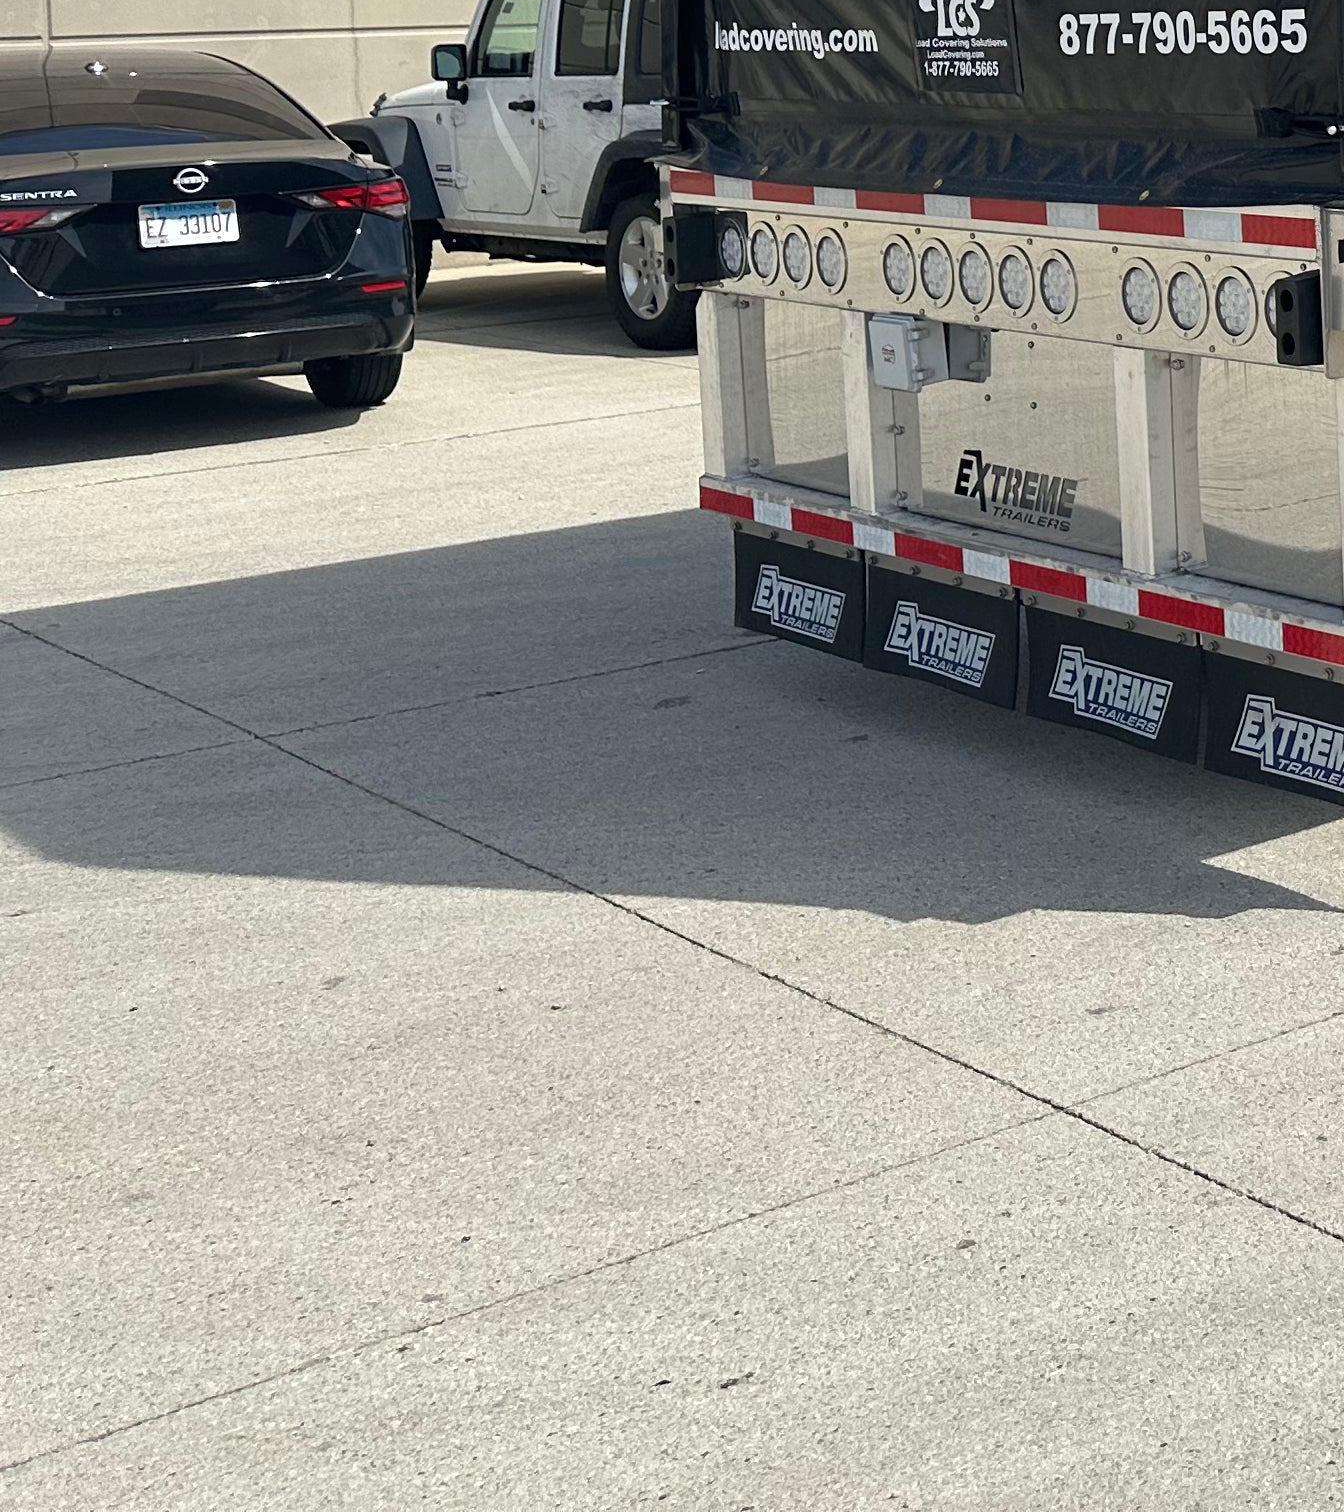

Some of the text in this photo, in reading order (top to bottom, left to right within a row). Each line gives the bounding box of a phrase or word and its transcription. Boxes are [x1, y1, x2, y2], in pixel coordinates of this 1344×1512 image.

[931, 37, 970, 49] Covering
[1058, 8, 1308, 55] 877-790-5665
[924, 60, 1000, 77] 1-877-790-5665
[0, 189, 78, 202] SENTRA
[146, 211, 232, 239] EZ 33107
[954, 449, 1079, 519] EXTREME
[992, 505, 1072, 533] TRAILERS
[756, 570, 842, 627] EXTREME
[780, 615, 834, 638] TRAILERS
[896, 604, 991, 671] EXTREME
[921, 654, 982, 682] TRAILERS
[1054, 650, 1169, 722] EXTREME
[1088, 701, 1158, 734] TRAILERS
